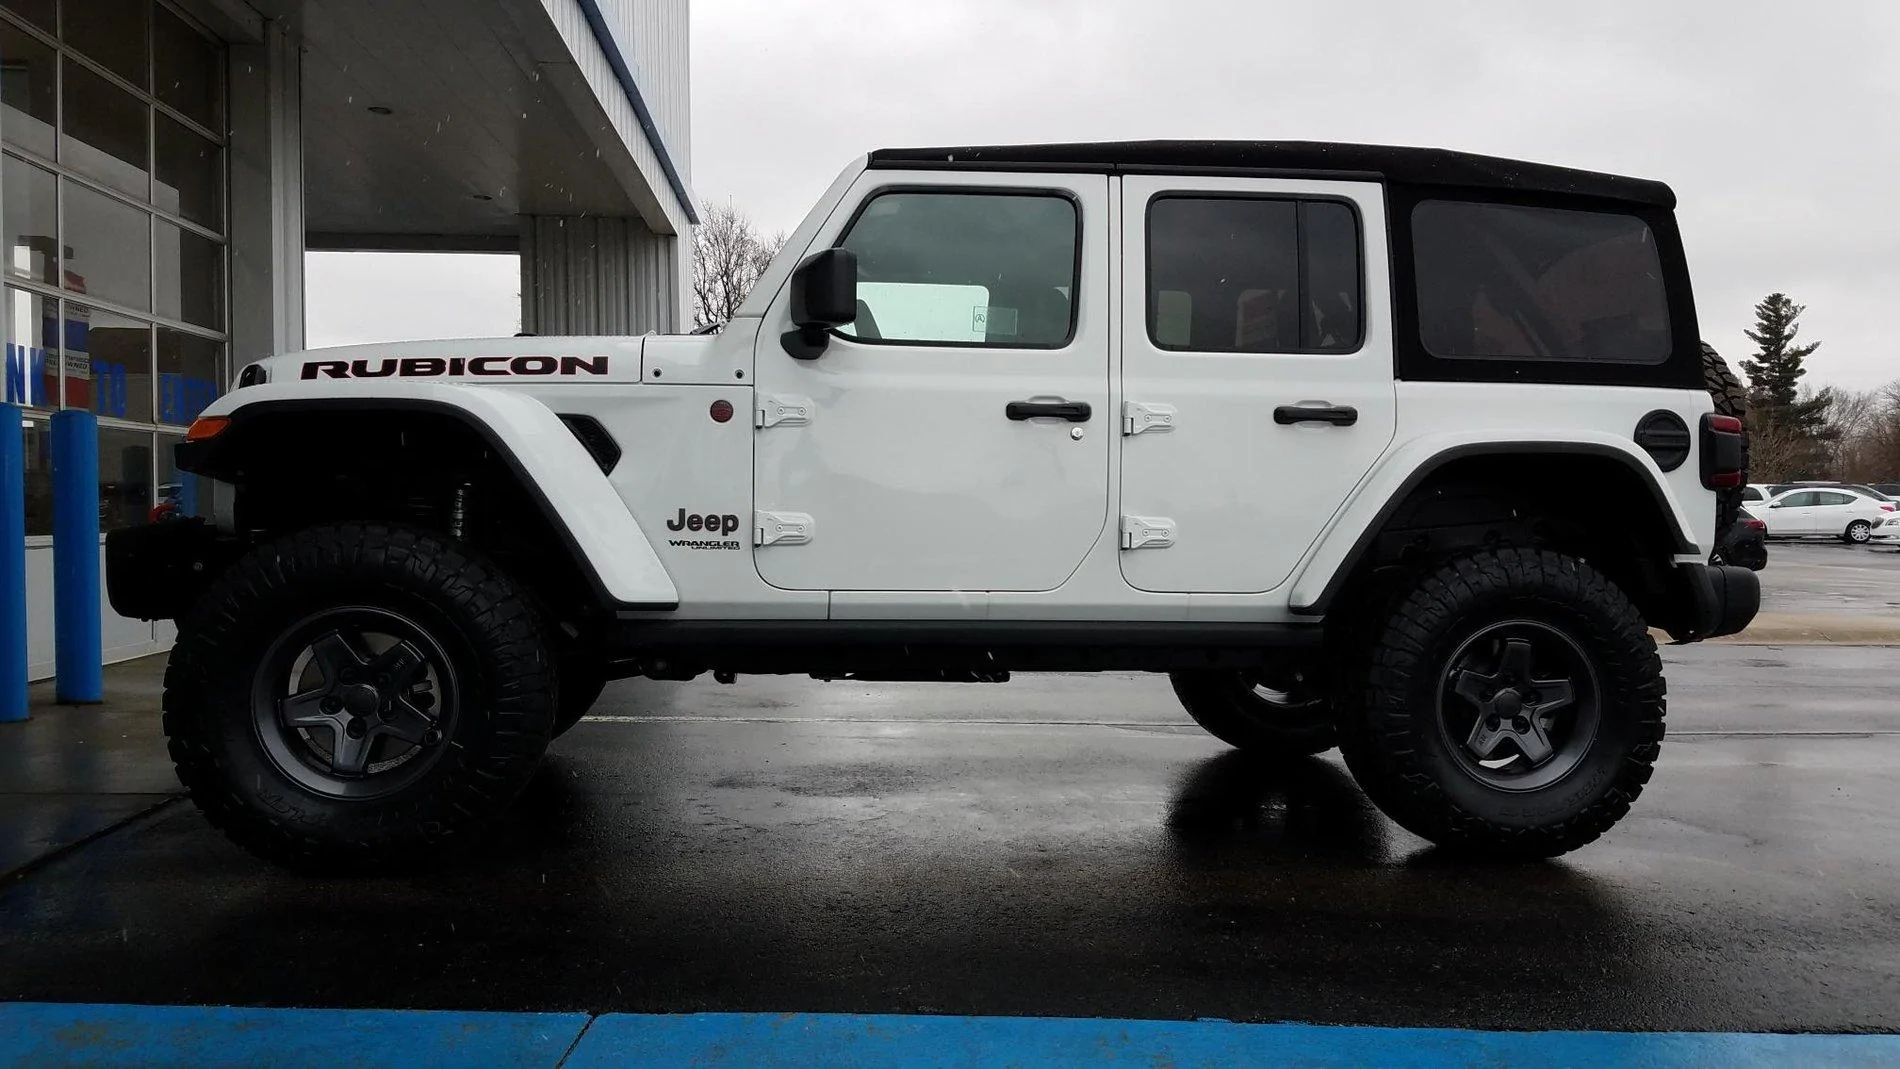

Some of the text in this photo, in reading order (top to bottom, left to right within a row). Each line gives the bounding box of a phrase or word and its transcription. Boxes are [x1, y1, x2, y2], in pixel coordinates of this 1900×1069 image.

[301, 356, 608, 380] RUBICON
[91, 359, 126, 419] TO
[667, 508, 739, 536] Jeep
